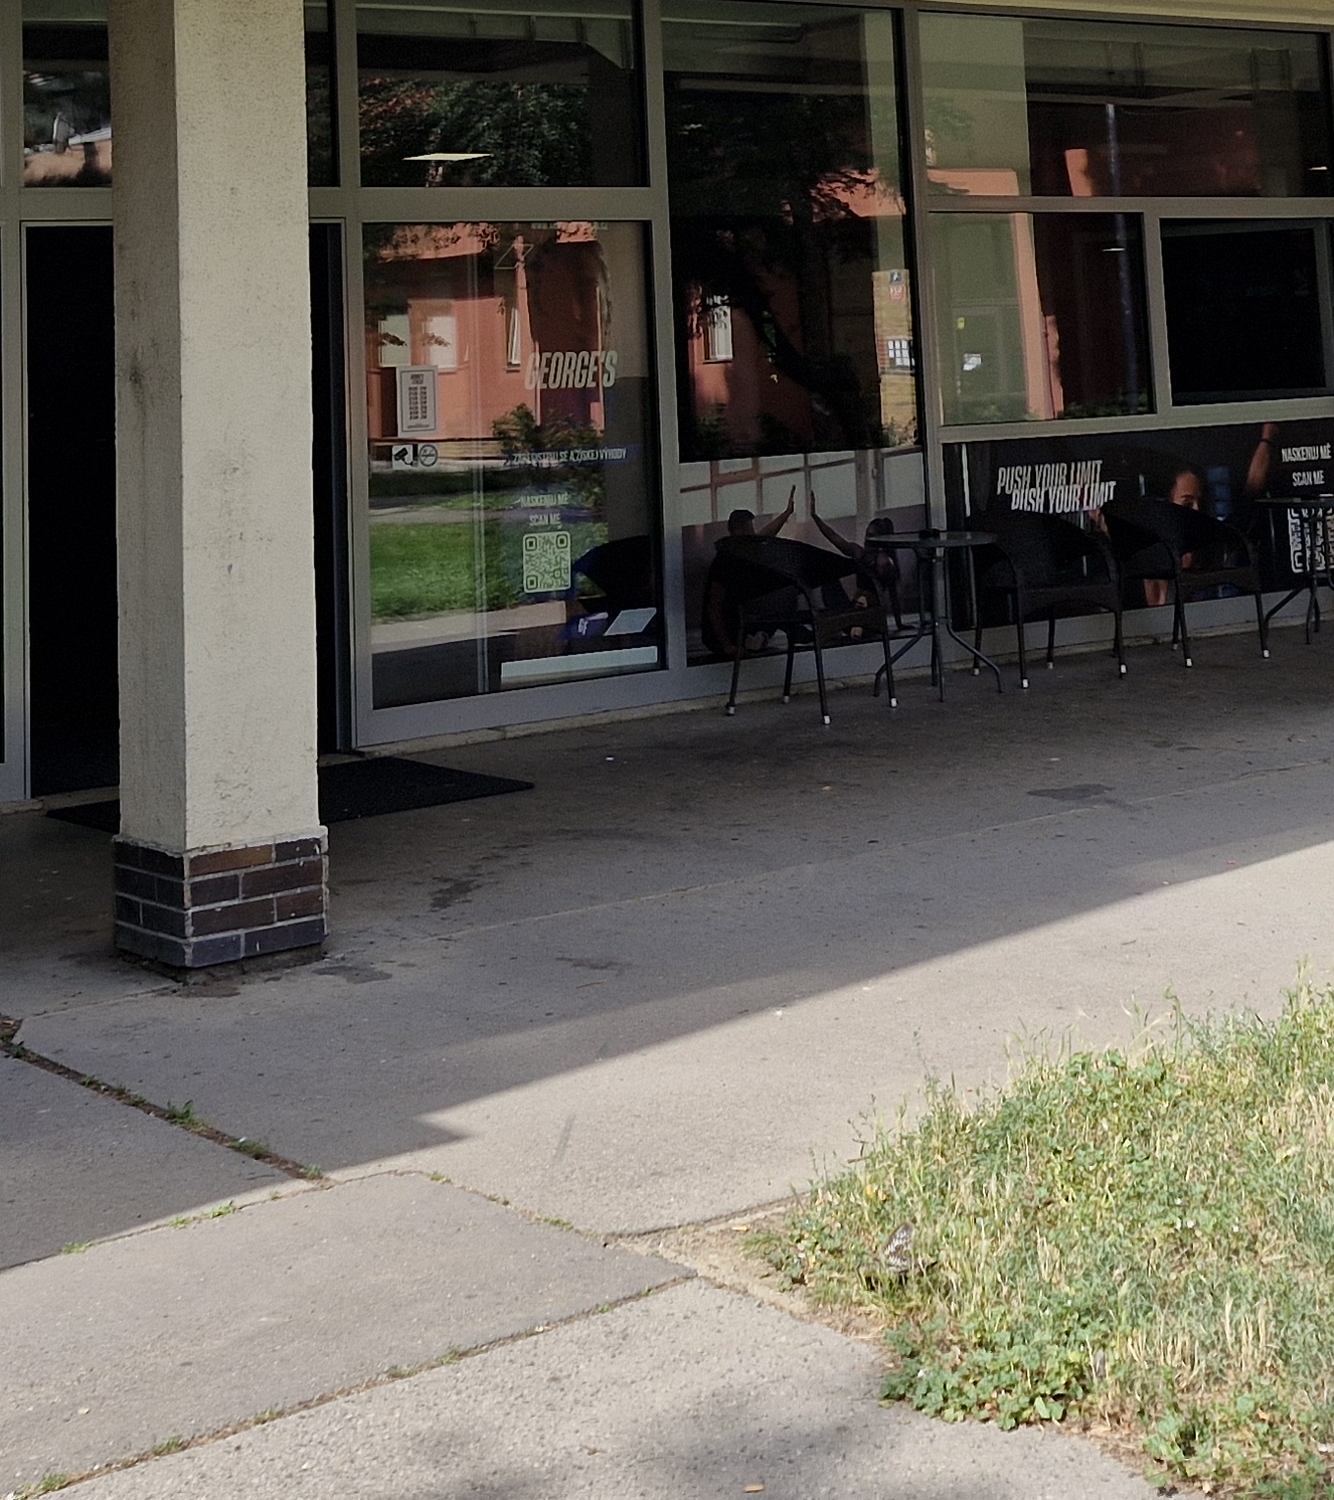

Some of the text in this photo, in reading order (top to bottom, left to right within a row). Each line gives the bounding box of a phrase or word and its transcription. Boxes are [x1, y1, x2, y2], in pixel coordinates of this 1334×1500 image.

[525, 350, 618, 390] GEORGE'S
[1281, 445, 1319, 463] NASKENUJ
[997, 459, 1103, 495] PUSH YOUR LIMIT
[1292, 469, 1325, 487] SCAN ME
[1048, 484, 1081, 514] YOUR
[1082, 481, 1116, 512] LIMIT
[529, 512, 562, 527] SCAN ME
